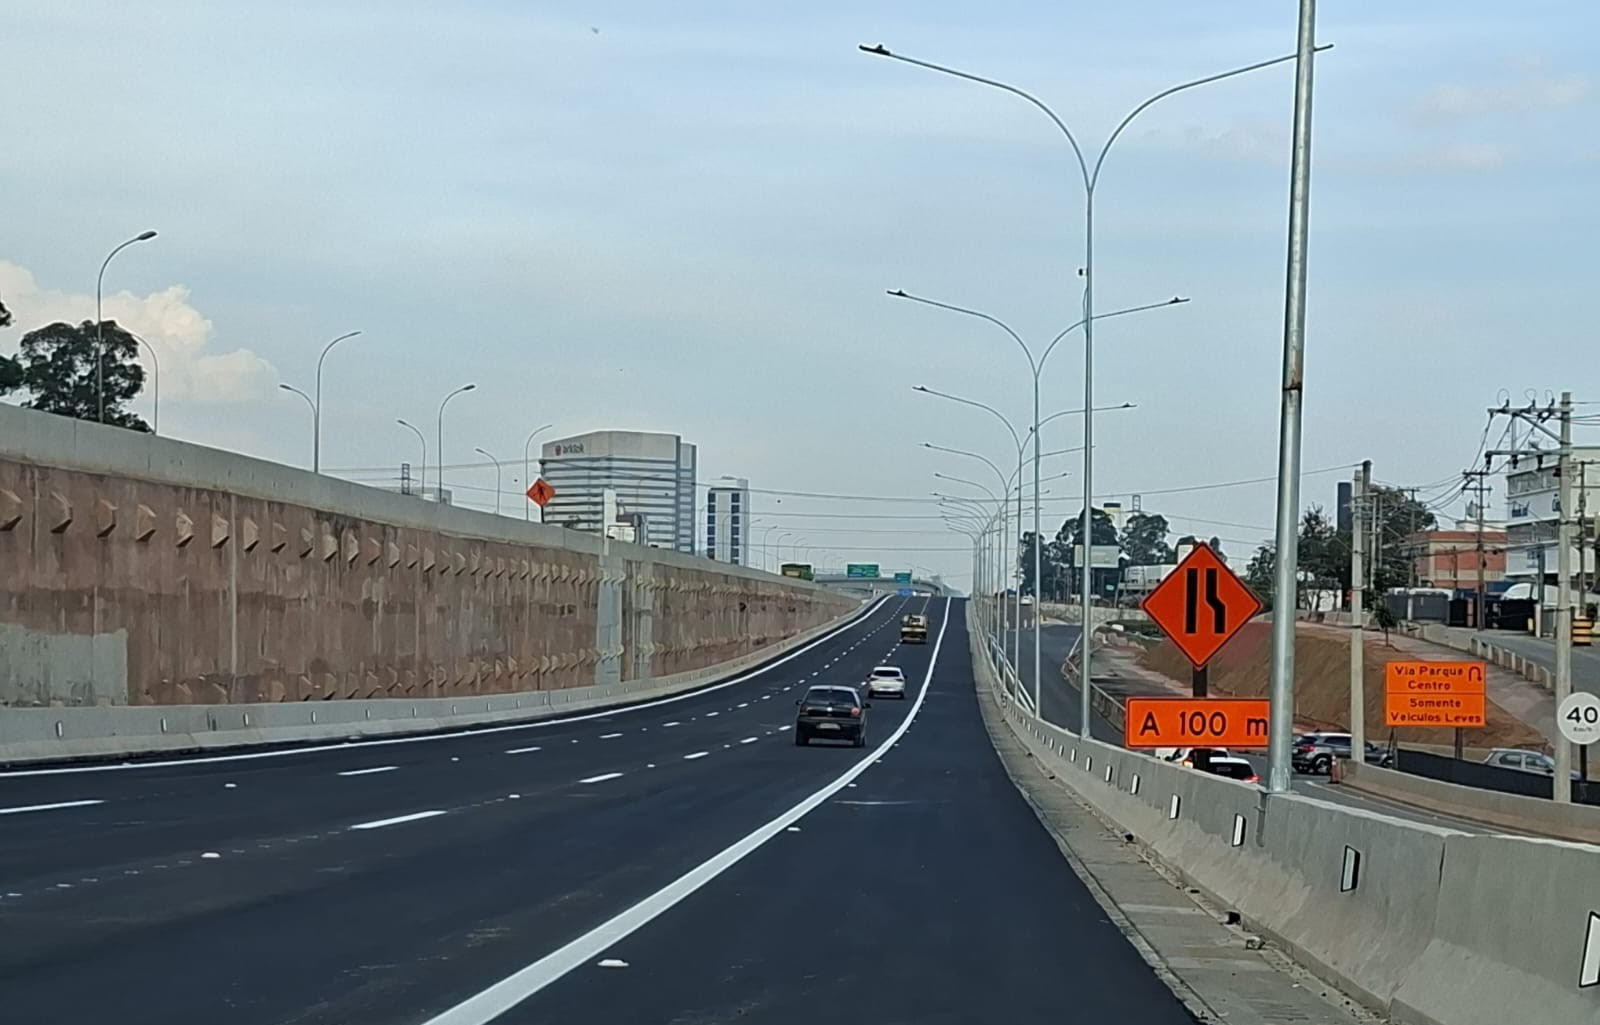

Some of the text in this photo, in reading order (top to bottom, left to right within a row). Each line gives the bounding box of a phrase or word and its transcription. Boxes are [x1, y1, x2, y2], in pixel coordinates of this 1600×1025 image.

[1394, 665, 1463, 678] Via Parque
[1408, 680, 1451, 690] Centro
[1410, 698, 1461, 708] Somente
[1445, 712, 1481, 723] Leves
[1566, 706, 1598, 724] 40
[1139, 711, 1268, 736] A 100 m
